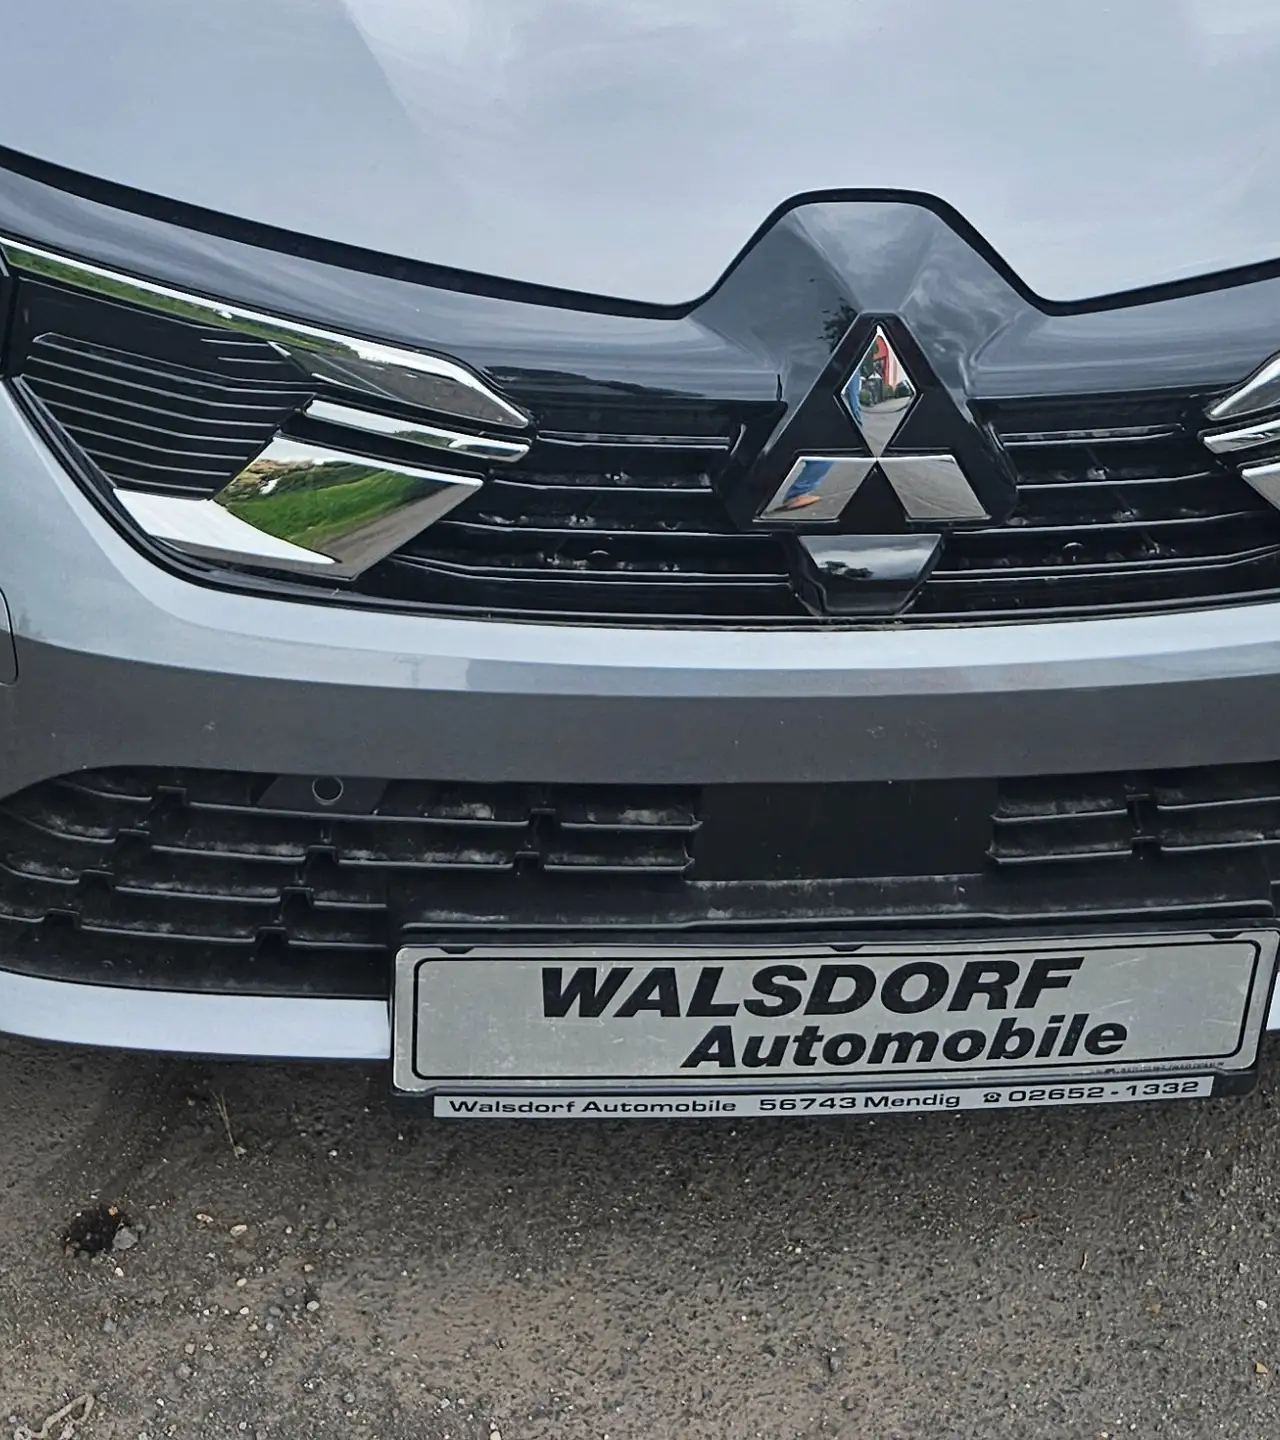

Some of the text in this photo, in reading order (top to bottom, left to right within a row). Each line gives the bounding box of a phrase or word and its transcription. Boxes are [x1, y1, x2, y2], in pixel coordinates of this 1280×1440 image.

[541, 956, 1085, 1018] WALSDORF
[680, 1013, 1128, 1068] Automobile
[449, 1100, 575, 1113] Walsdorf
[581, 1099, 736, 1113] Automobile
[759, 1097, 856, 1111] 56743
[863, 1093, 960, 1108] Mendig
